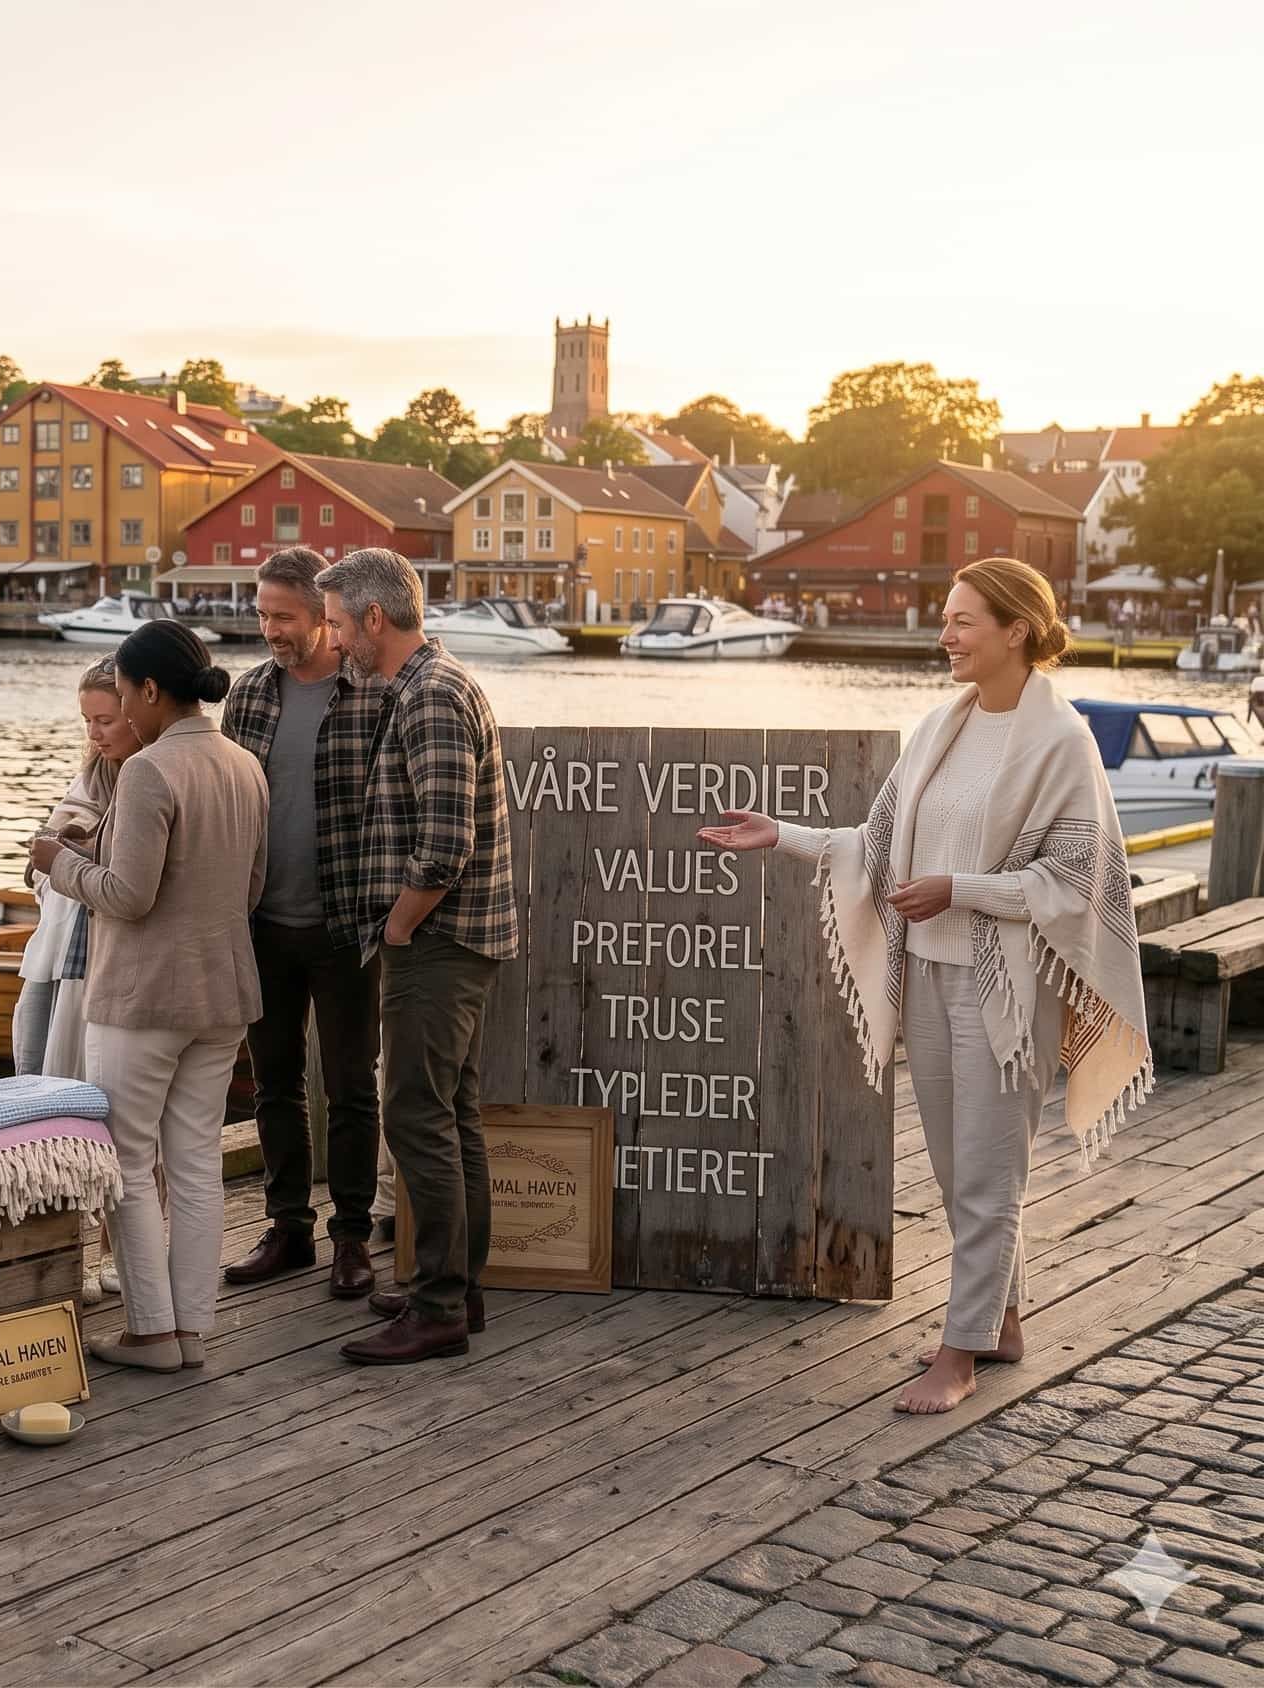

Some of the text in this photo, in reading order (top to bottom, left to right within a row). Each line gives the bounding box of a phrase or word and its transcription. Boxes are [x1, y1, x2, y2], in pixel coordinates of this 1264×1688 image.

[505, 745, 830, 817] VÅRE VERDIER
[593, 847, 739, 896] VALUES
[570, 920, 763, 970] PREFOREL
[601, 992, 726, 1044] TRUSE
[570, 1067, 756, 1121] TYPLEDER
[527, 1179, 577, 1197] HAVEN
[613, 1144, 775, 1198] ETIERET
[17, 1336, 68, 1363] HAVEN
